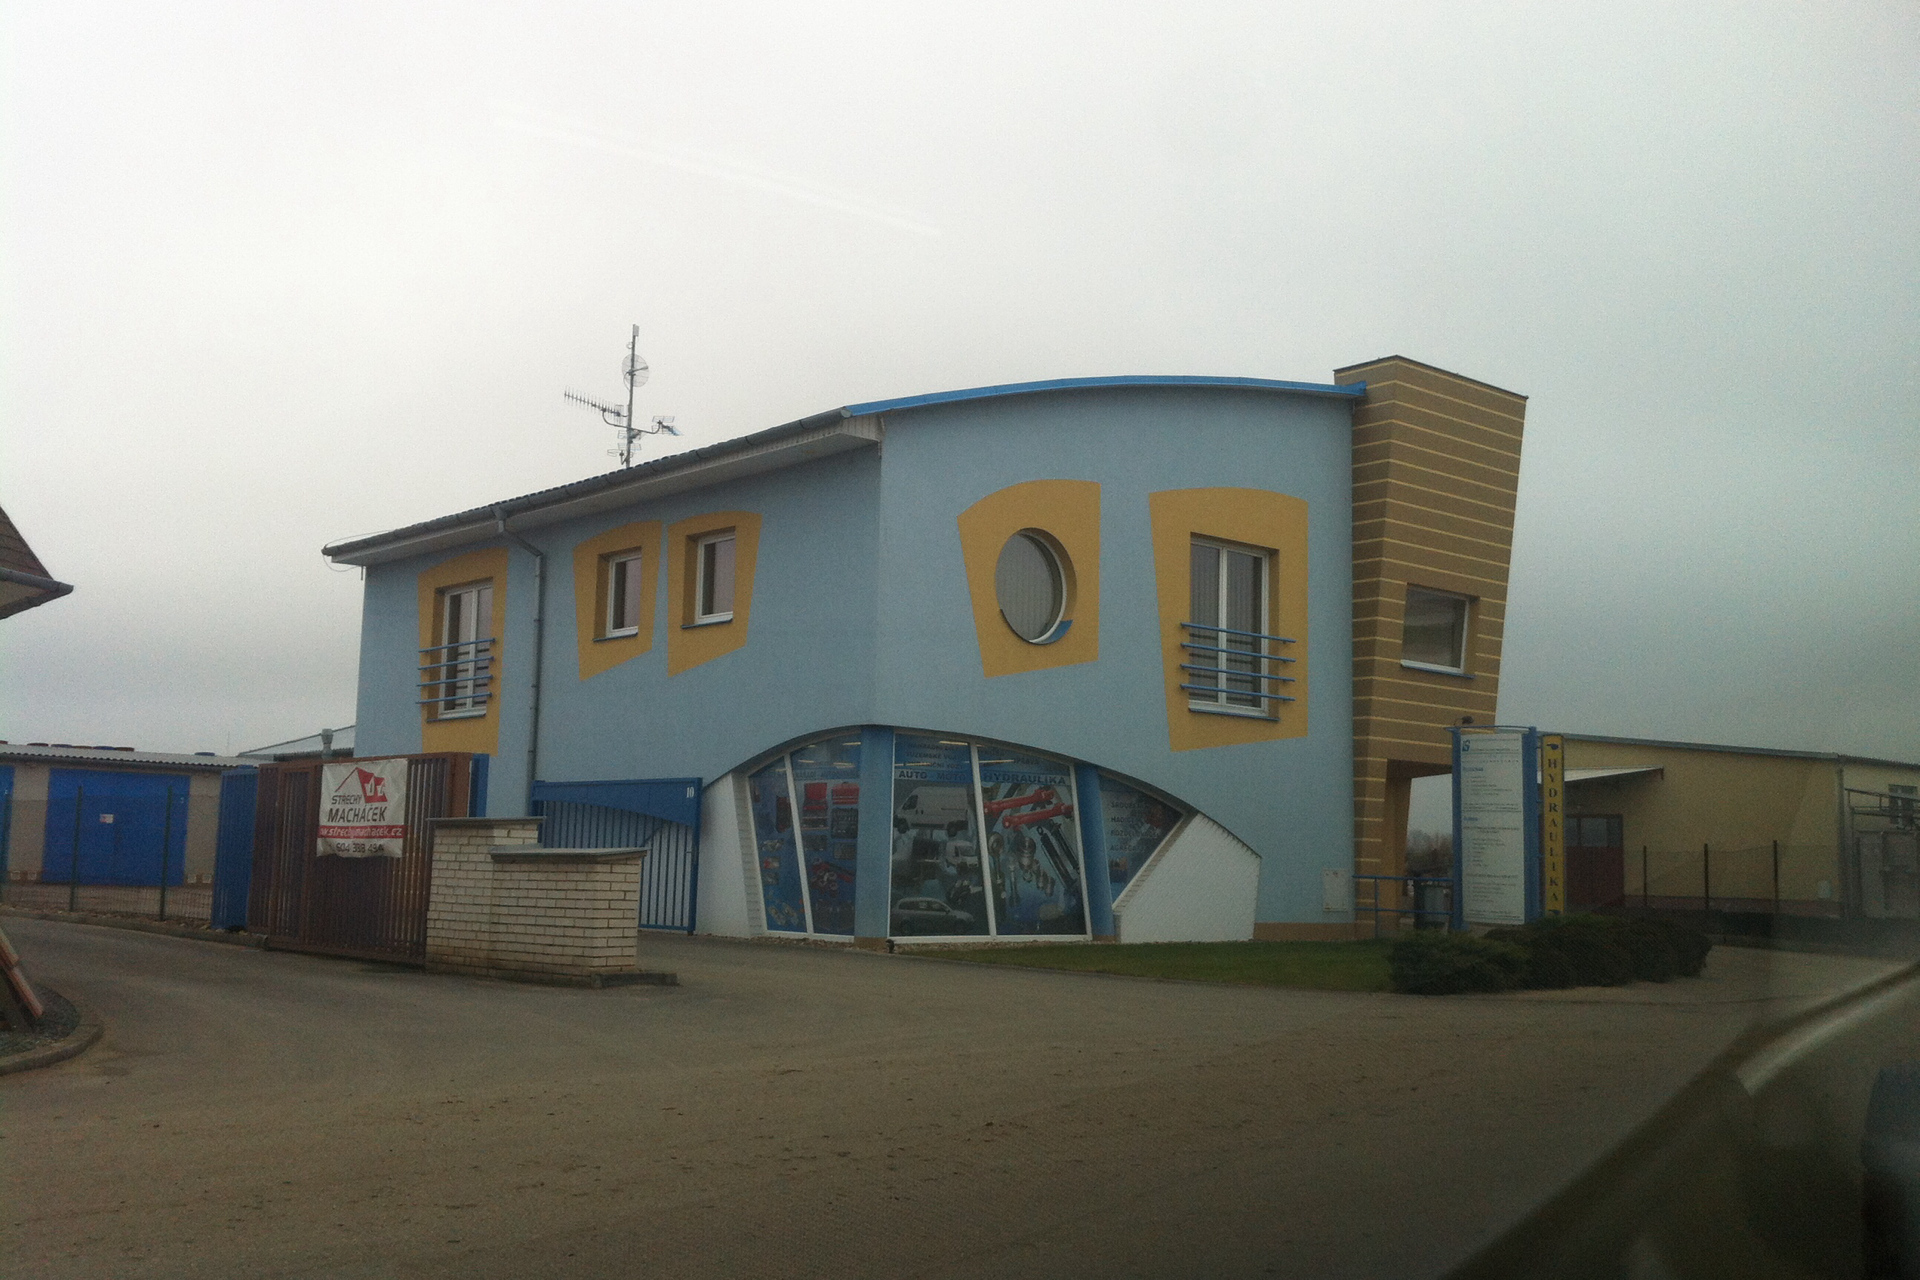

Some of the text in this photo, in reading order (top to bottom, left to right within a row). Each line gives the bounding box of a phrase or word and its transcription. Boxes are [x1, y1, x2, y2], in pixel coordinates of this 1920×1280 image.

[899, 769, 1066, 785] AUTO MOTO HYDRAULIKA
[686, 786, 695, 798] 10
[327, 804, 387, 822] MACHÁČEK
[1547, 758, 1559, 902] HYDRAULIKA
